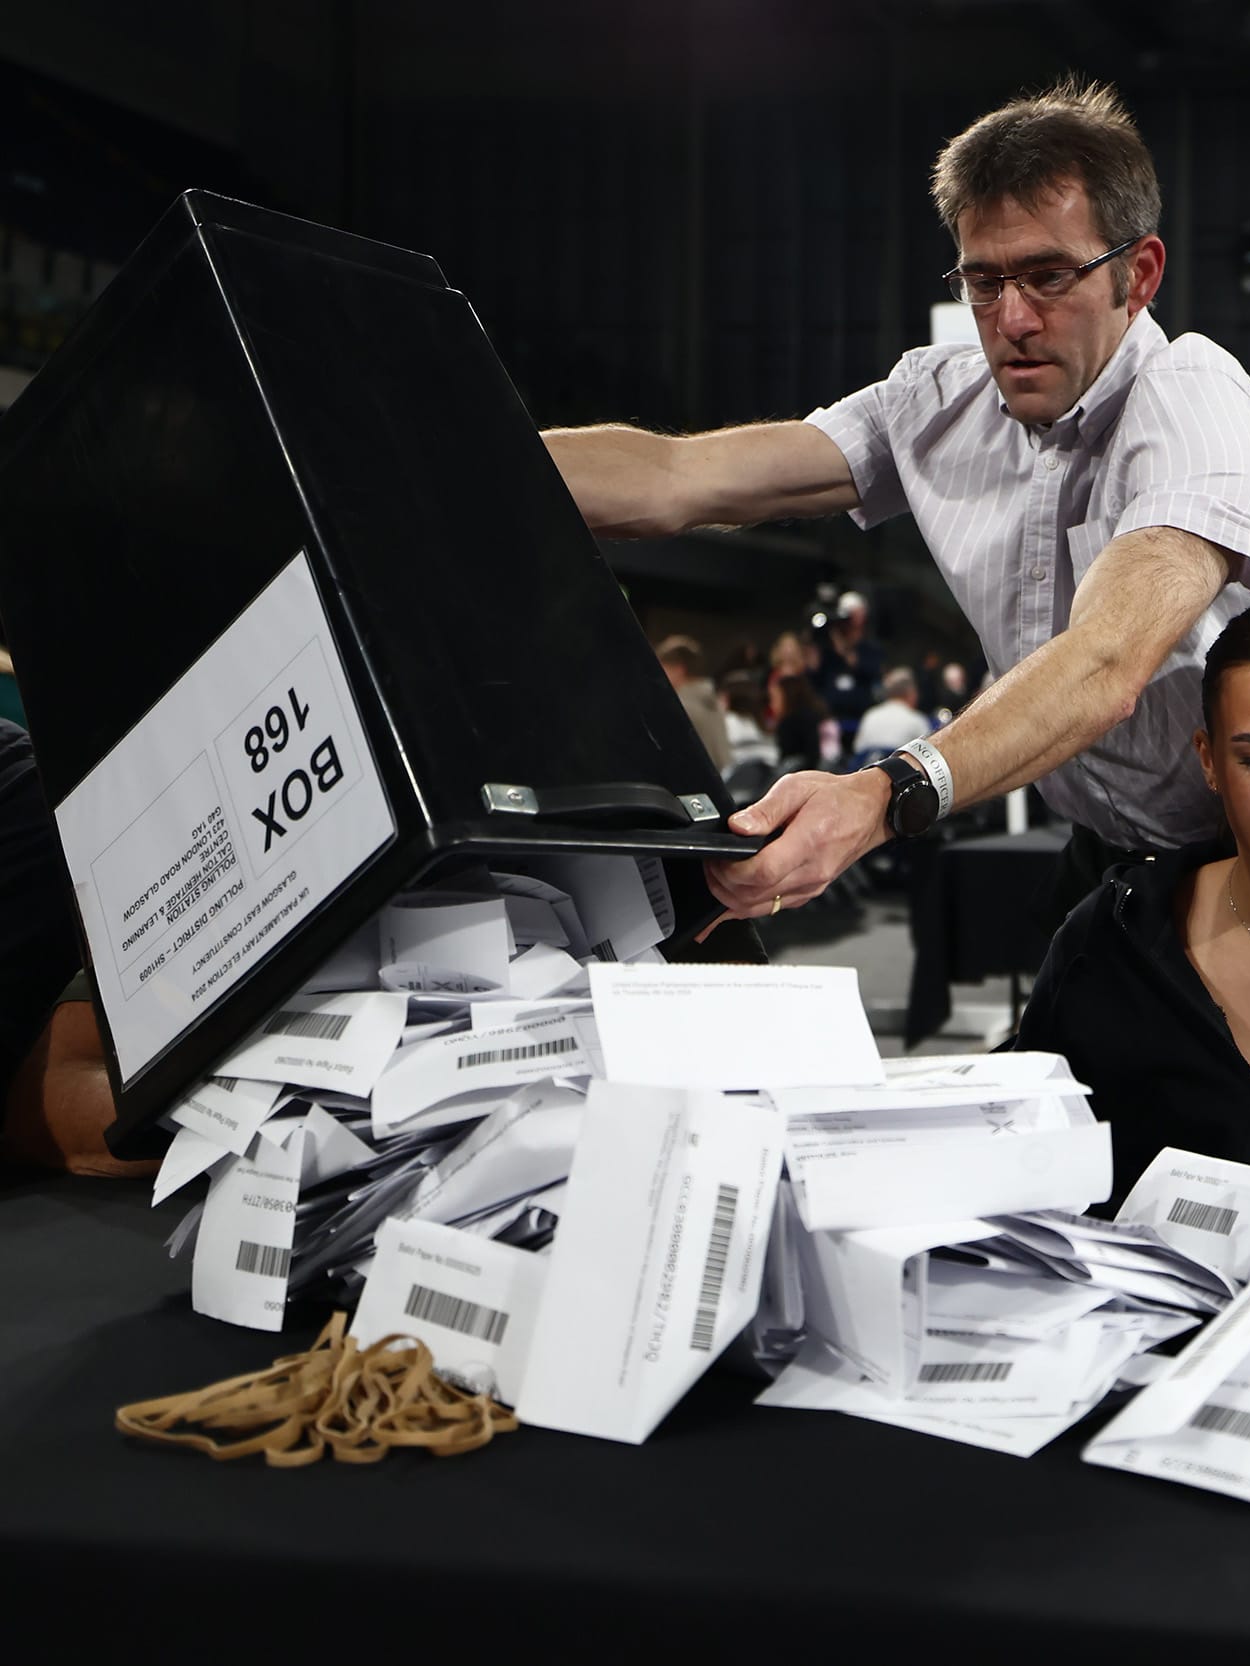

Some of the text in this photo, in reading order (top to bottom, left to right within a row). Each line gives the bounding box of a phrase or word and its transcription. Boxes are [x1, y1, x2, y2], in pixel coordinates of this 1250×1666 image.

[244, 687, 310, 774] 168
[191, 805, 222, 840] G40 1AG
[251, 735, 344, 853] BOX
[123, 818, 225, 922] 423 LONDON ROAD GLASGOW
[199, 829, 229, 863] CENTRE
[121, 841, 233, 952] CALTON HERITAGE & LEARNING
[166, 853, 237, 926] POLLING STATION
[192, 870, 297, 975] GLASGOW EAST CONSTITUENCY
[208, 879, 244, 917] POLLING
[139, 953, 166, 983] SH1009
[173, 913, 209, 952] DISTRICT
[192, 887, 310, 1002] UK PARLIAMENTARY ELECTION 2024
